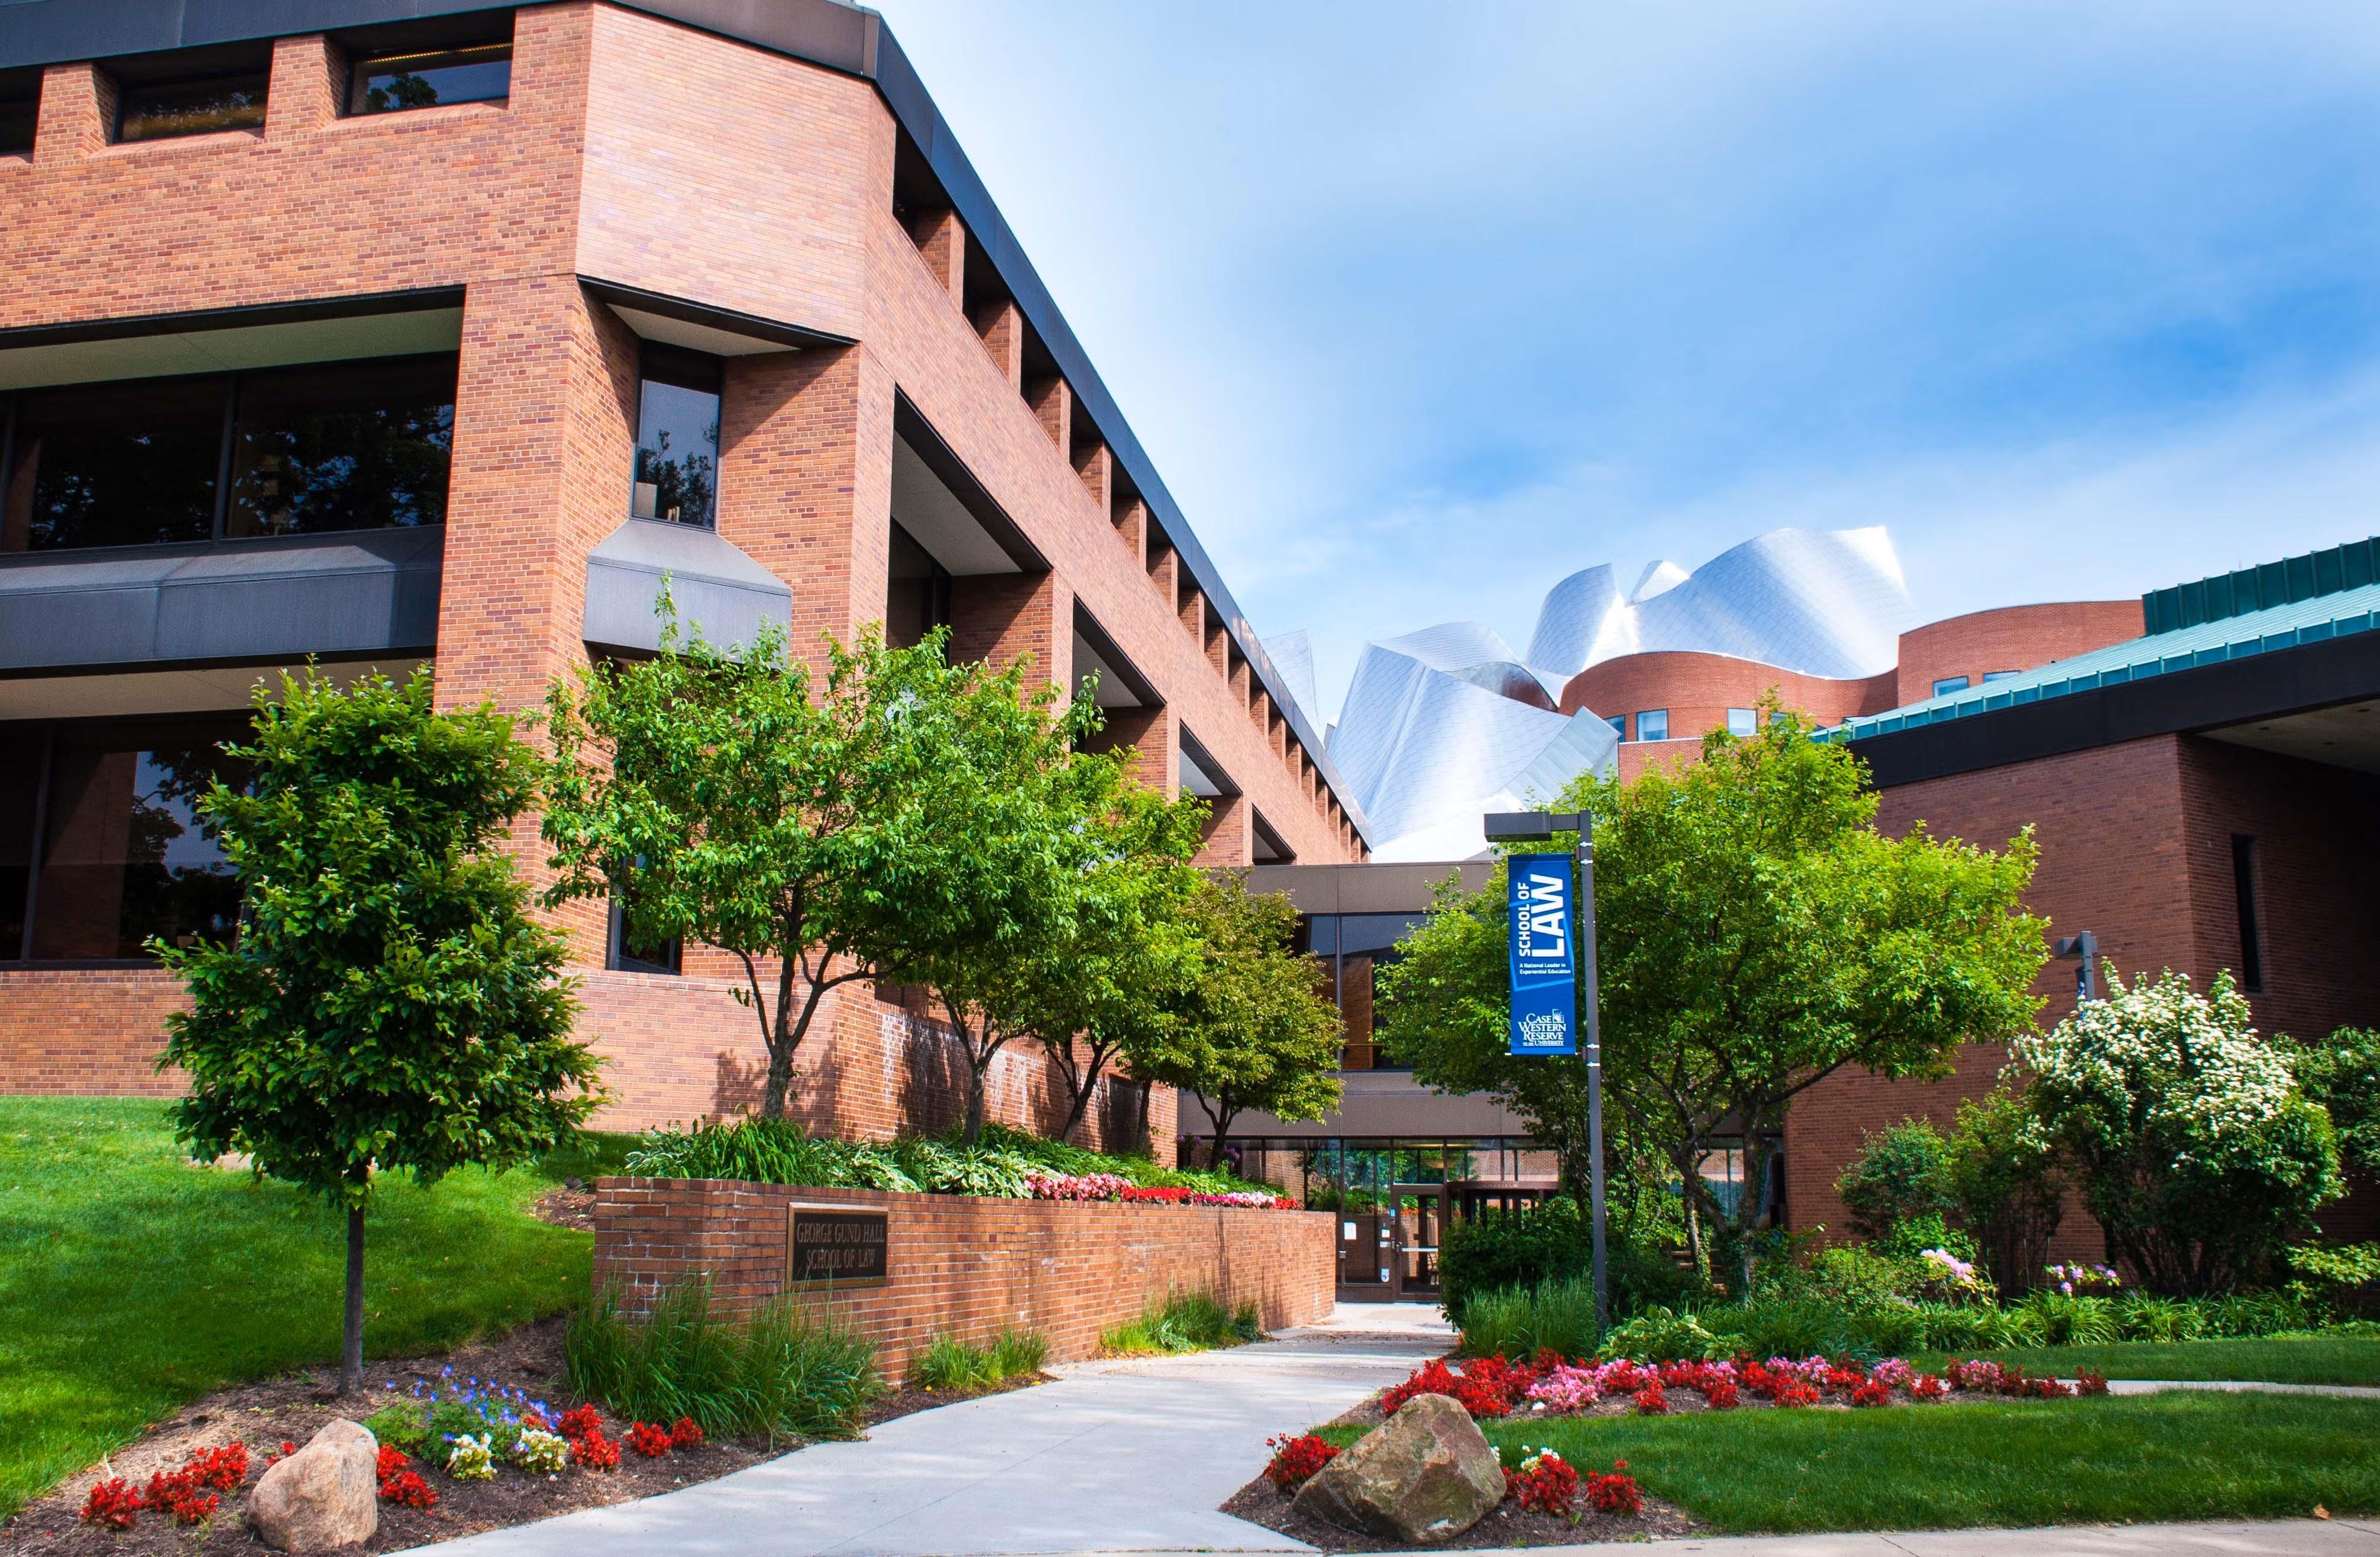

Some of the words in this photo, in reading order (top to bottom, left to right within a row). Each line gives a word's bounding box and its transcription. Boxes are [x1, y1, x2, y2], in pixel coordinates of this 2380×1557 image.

[1518, 882, 1529, 900] OF
[1530, 874, 1564, 957] LAW
[1518, 904, 1531, 957] SCHOOL
[1518, 1022, 1567, 1032] WESTERN
[1526, 1013, 1552, 1023] CASE
[1524, 1031, 1564, 1042] RESERVE
[797, 1223, 832, 1243] GEORGE
[835, 1223, 861, 1243] GUND
[864, 1225, 885, 1242] HALL
[806, 1249, 842, 1269] SCHOOL
[844, 1249, 855, 1268] OF
[858, 1249, 876, 1268] LAW
